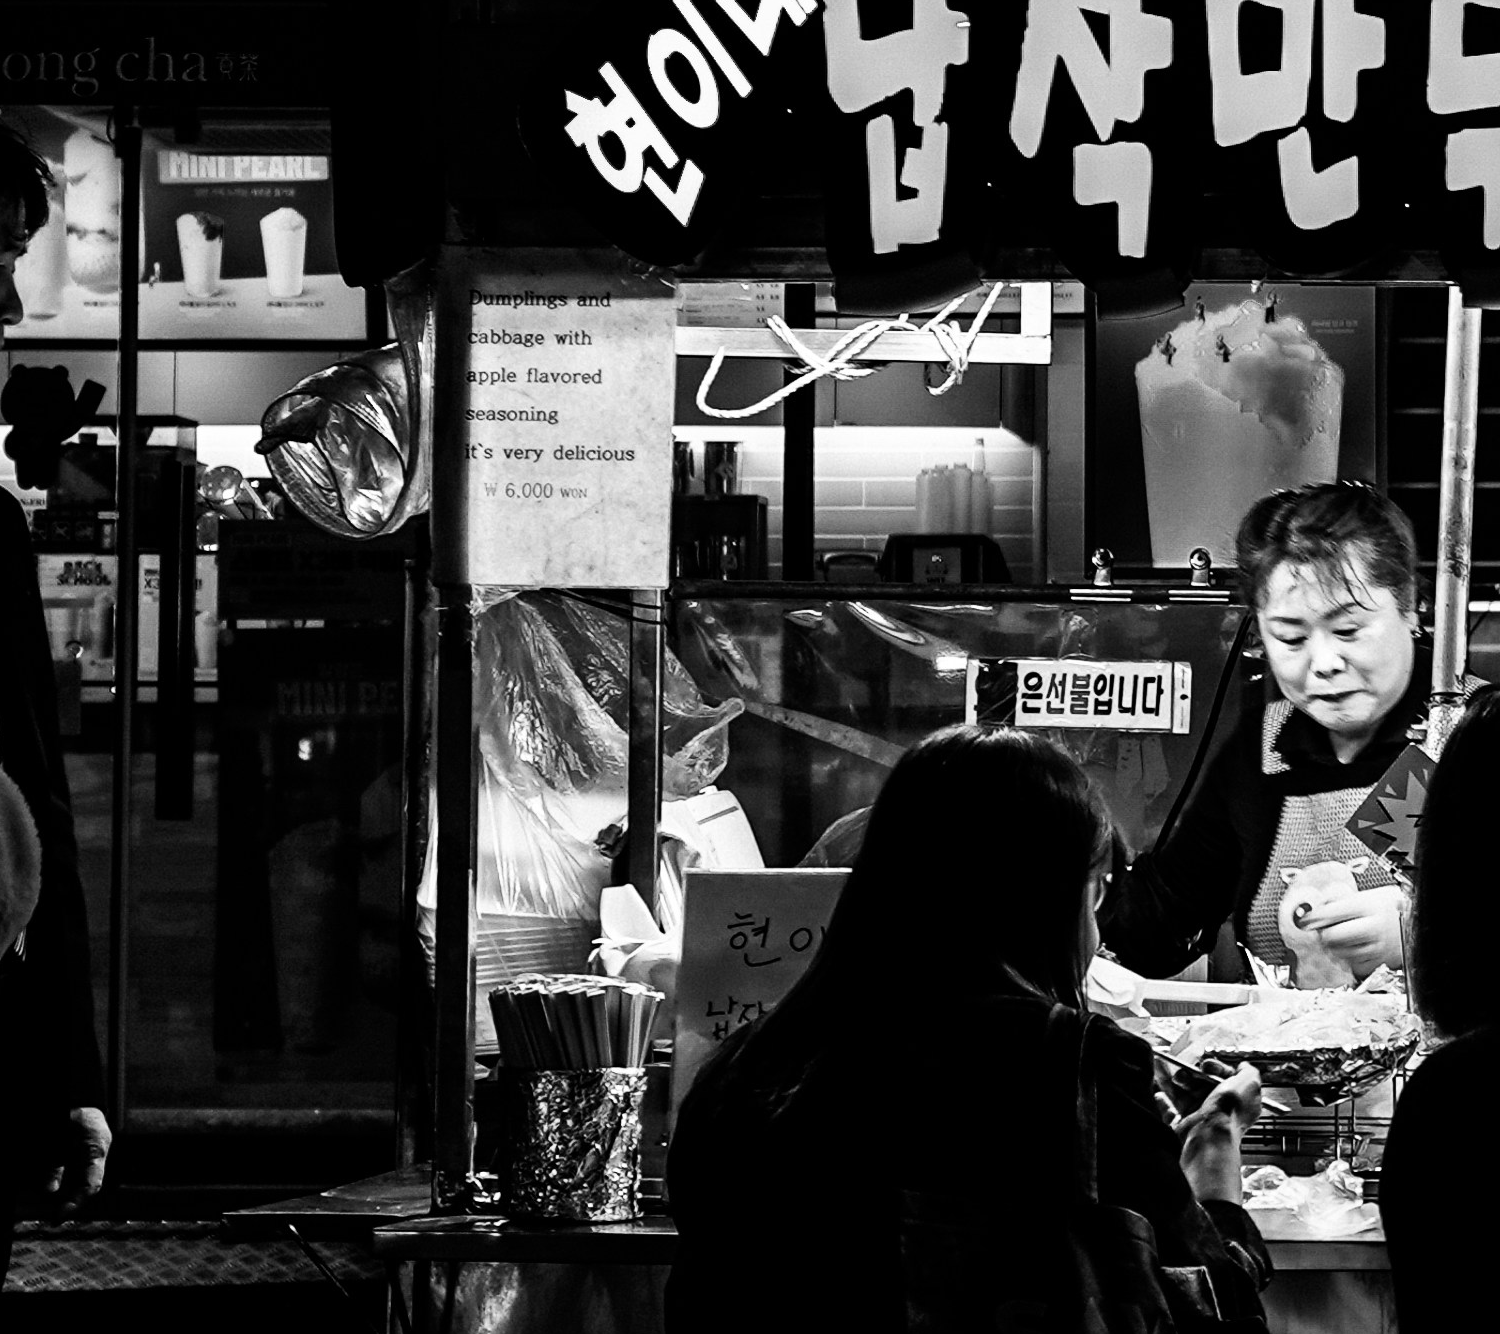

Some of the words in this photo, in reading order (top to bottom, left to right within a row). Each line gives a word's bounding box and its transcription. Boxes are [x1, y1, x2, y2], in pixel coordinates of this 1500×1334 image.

[115, 35, 208, 83] cha
[168, 151, 226, 179] MINI
[232, 156, 321, 179] PEARL
[468, 289, 568, 310] Dumplings
[576, 291, 612, 308] and
[467, 329, 546, 348] cabbage
[554, 329, 593, 346] with
[466, 367, 518, 386] apple
[526, 367, 603, 385] flavored
[465, 406, 560, 425] seasoning
[502, 447, 544, 463] very
[552, 445, 636, 462] delicious
